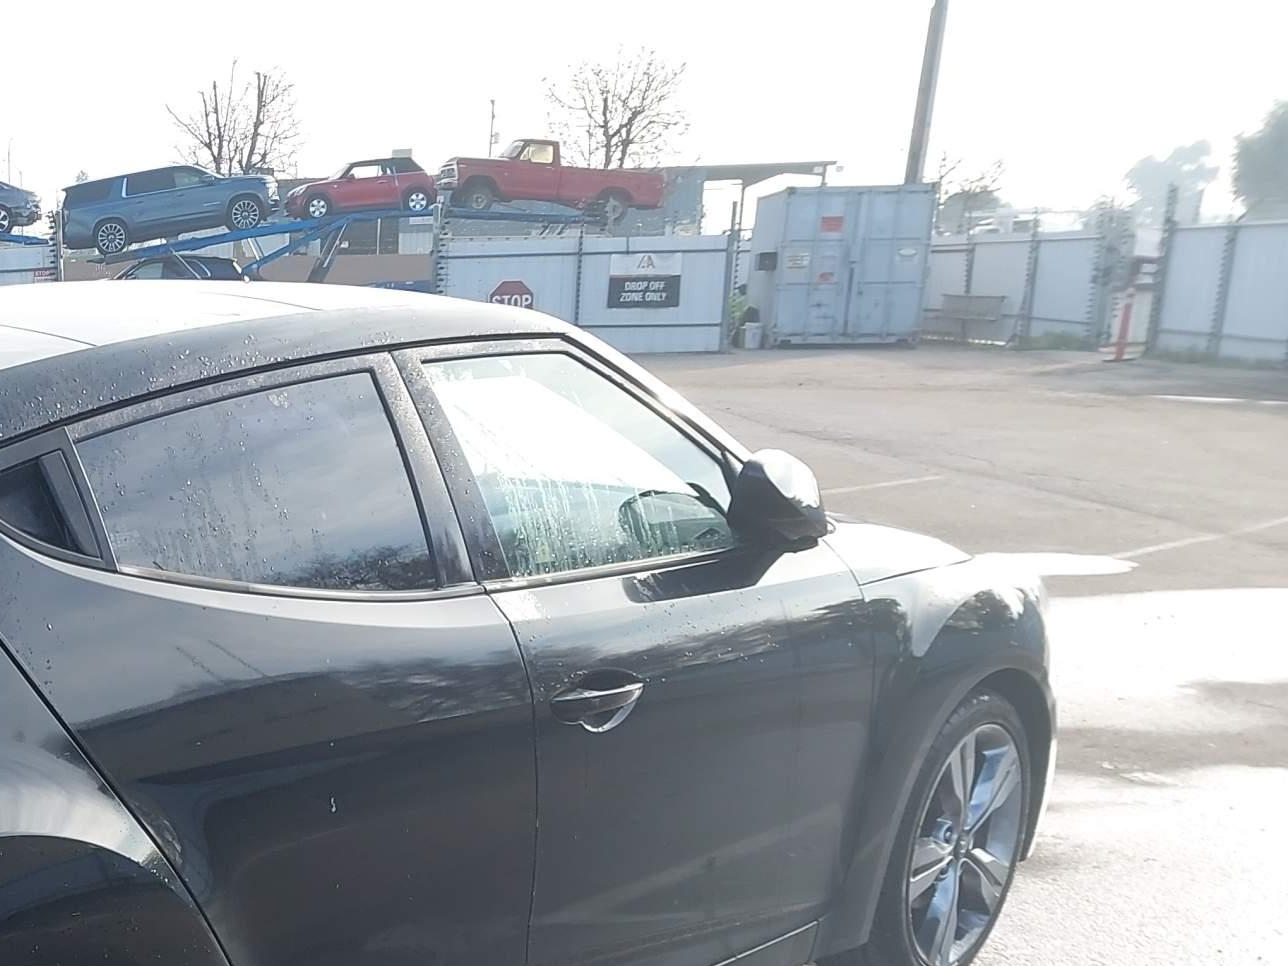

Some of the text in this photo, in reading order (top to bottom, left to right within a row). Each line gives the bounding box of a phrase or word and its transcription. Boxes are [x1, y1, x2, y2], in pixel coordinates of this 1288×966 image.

[624, 281, 665, 291] DROP OFF
[619, 292, 667, 302] ZONE ONLY
